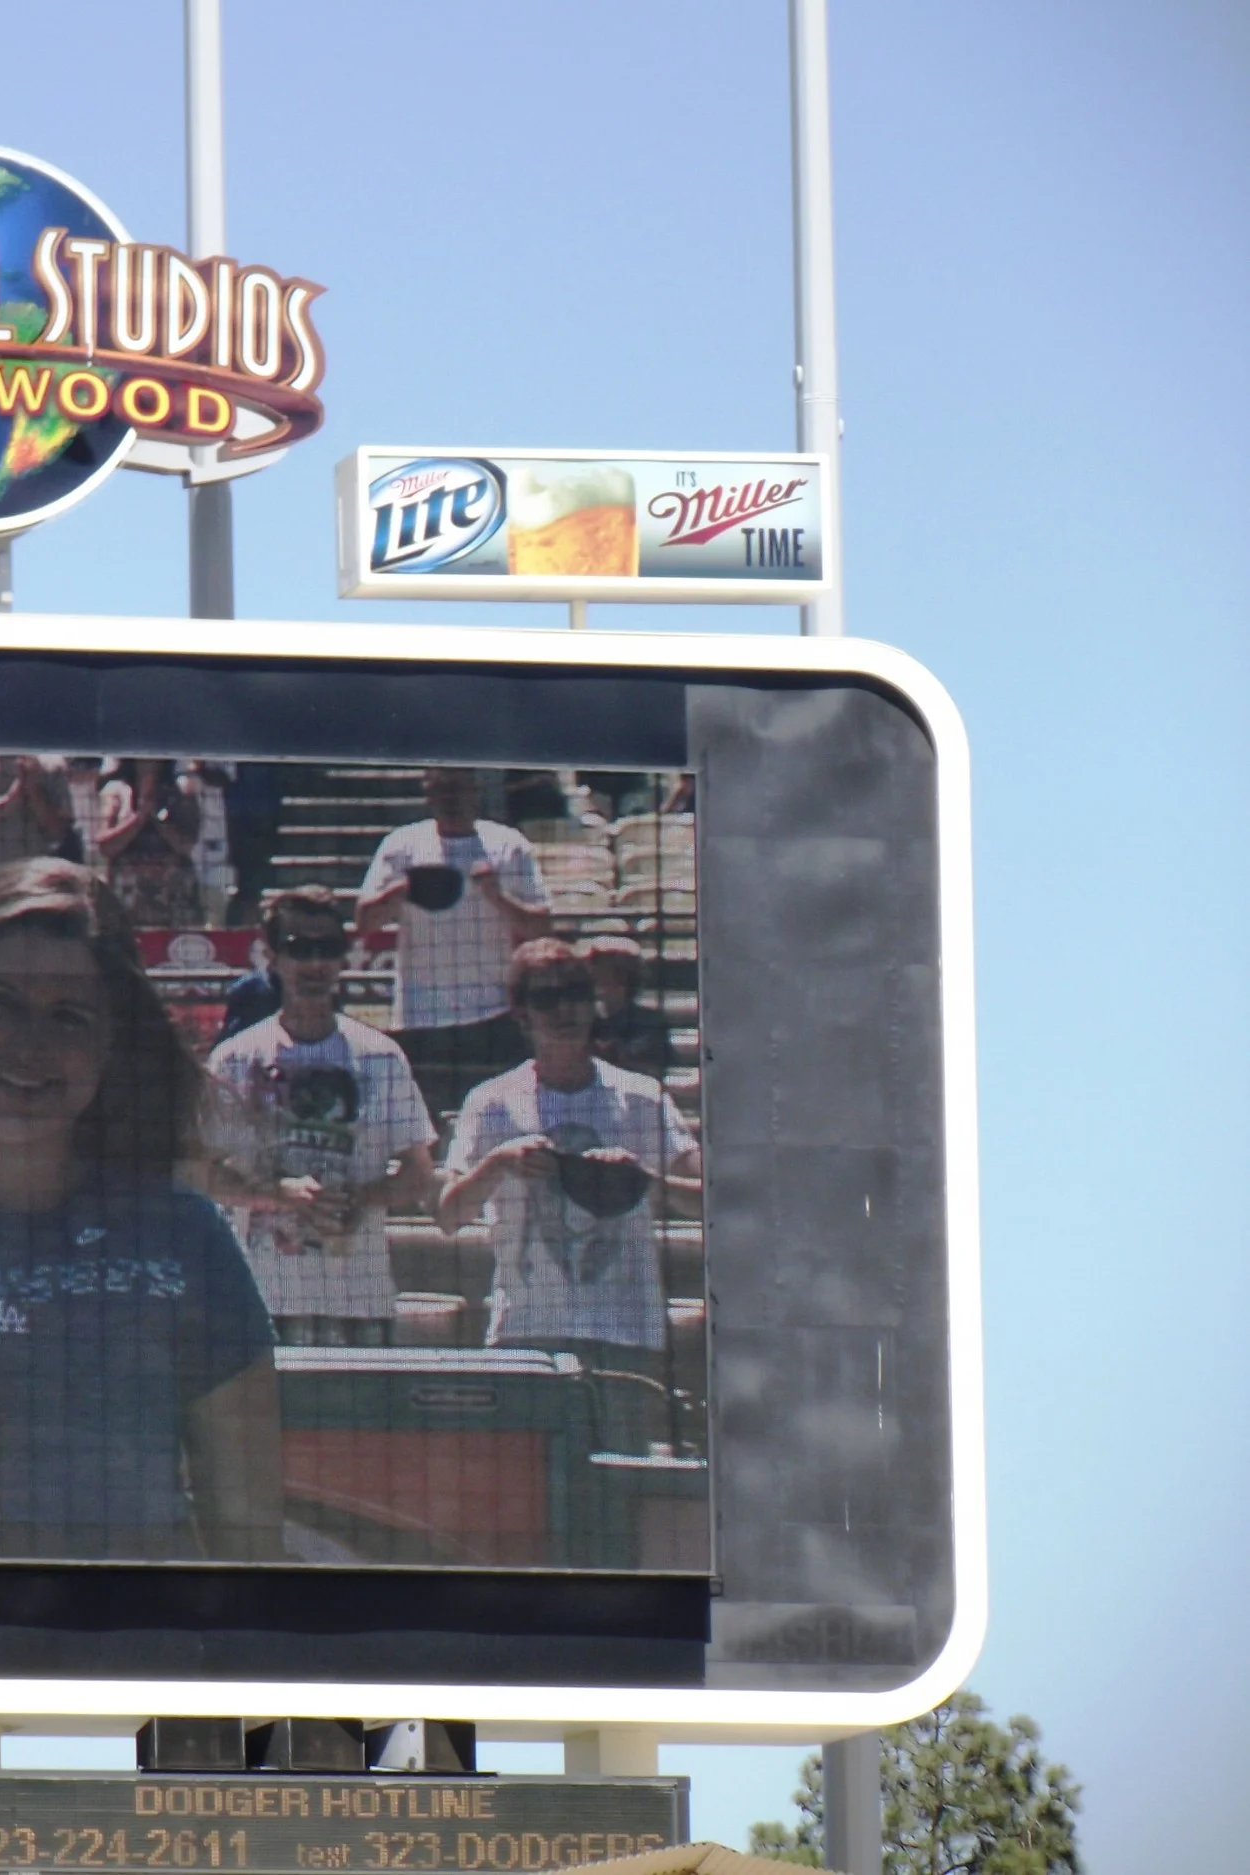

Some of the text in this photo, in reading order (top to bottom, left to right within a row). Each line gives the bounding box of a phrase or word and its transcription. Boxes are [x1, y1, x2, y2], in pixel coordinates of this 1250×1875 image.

[36, 228, 320, 391] STUDIOS
[389, 470, 452, 496] Miller
[675, 471, 697, 488] IT'S
[370, 477, 488, 571] Lite
[647, 478, 809, 539] Miller
[741, 527, 805, 568] TIME
[134, 1785, 496, 1819] DODGER HOTLINE
